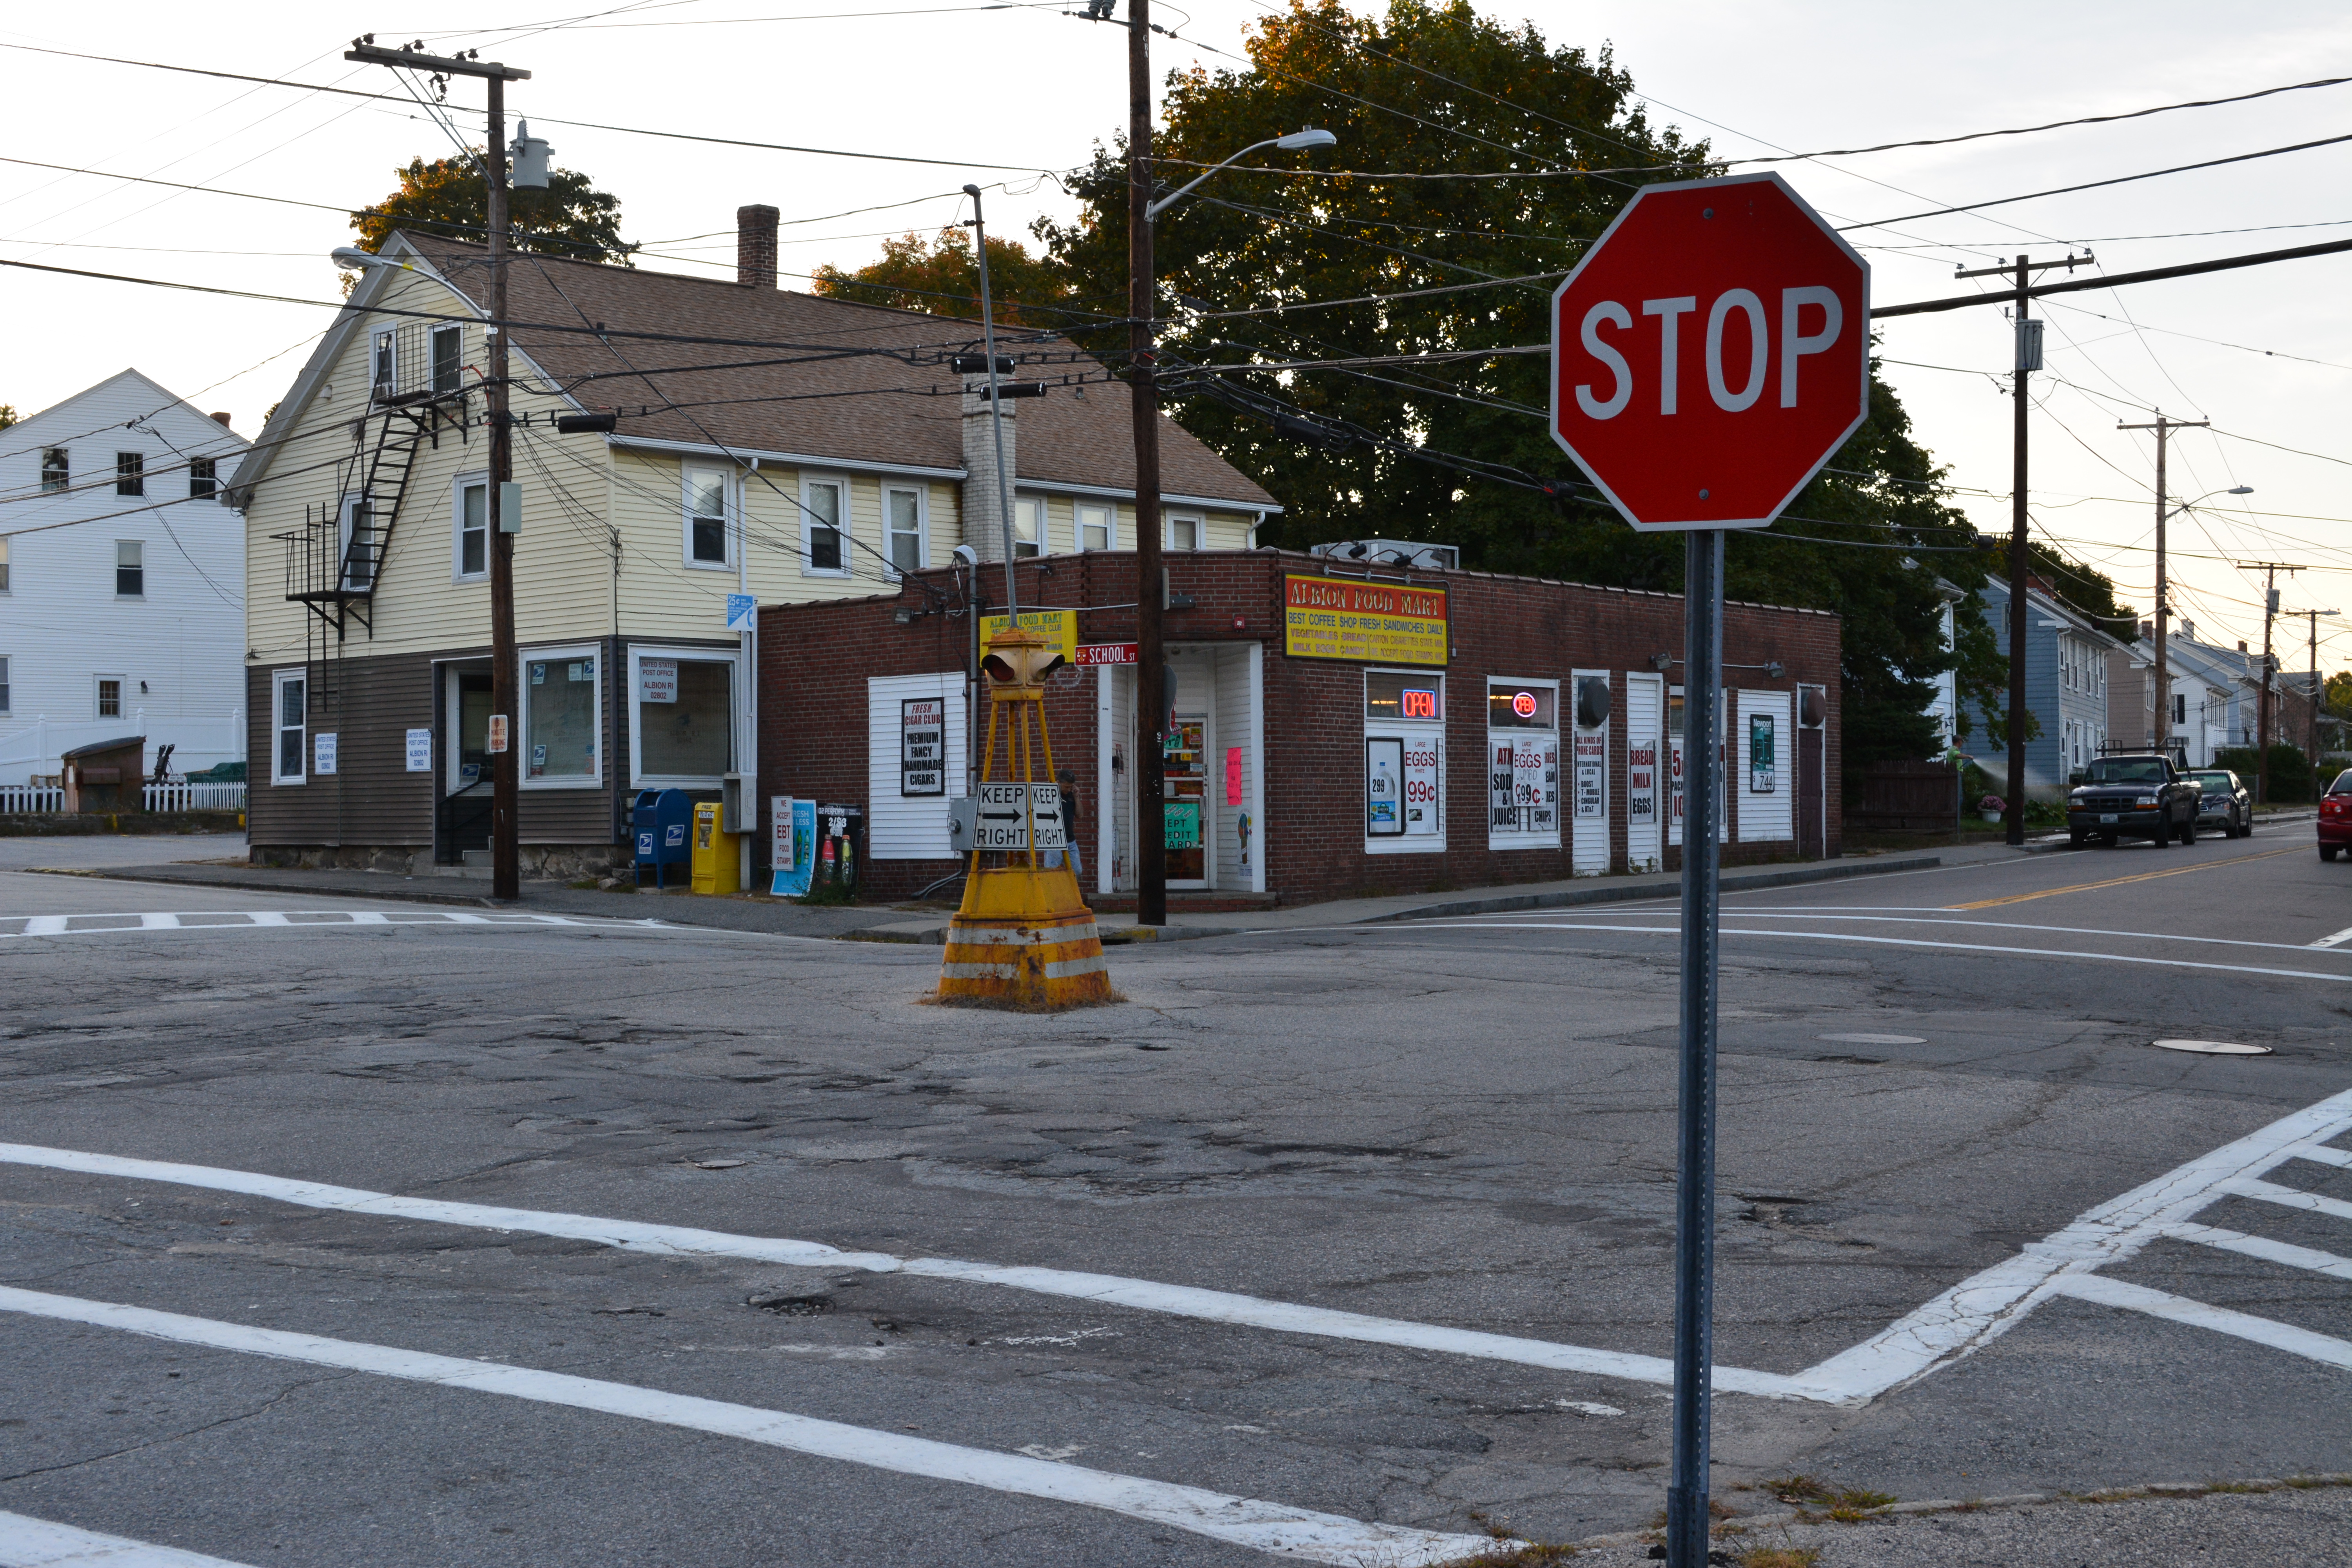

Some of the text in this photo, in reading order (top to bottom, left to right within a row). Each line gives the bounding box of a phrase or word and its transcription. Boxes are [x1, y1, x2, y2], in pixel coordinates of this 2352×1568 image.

[1575, 285, 1843, 420] STOP
[1291, 583, 1439, 616] ALBION FOOD MART
[990, 613, 1062, 628] ALBIO FOOD MART
[1289, 612, 1443, 635] BEST COFFEE SHOP FRESH SANDWICHES DAILY
[1291, 628, 1367, 642] VEGETABLES BREAD
[1369, 634, 1388, 644] CARTON
[1390, 635, 1418, 646] CIGARETTES
[1420, 638, 1433, 647] STATE
[1089, 646, 1135, 663] SCHOOL ST
[1293, 642, 1365, 655] MILK EGGS CANDY
[1381, 648, 1398, 657] ACCEPT
[1400, 650, 1413, 659] FOOD
[1416, 651, 1433, 660] STAMPS
[912, 704, 932, 714] FRESH
[1405, 692, 1434, 717] OPEN
[1515, 698, 1535, 712] OPEN
[905, 714, 940, 726] CIGAR CLUB
[1753, 718, 1771, 728] Newport
[907, 732, 939, 744] PREMIUM
[911, 746, 932, 758] FANCY
[1589, 746, 1603, 755] CARDS
[905, 759, 941, 771] HANDMADE
[1405, 751, 1435, 767] EGGS
[1514, 754, 1541, 768] EGGS
[1631, 750, 1653, 766] BREAD
[910, 773, 935, 785] CIGARS
[1517, 768, 1537, 780] JUMBO
[1546, 771, 1555, 782] EAM
[1633, 773, 1651, 788] MILK
[1372, 779, 1385, 793] 299
[1408, 781, 1435, 804] 99¢
[982, 788, 1024, 803] KEEP
[1033, 788, 1057, 804] KEEP
[1502, 792, 1508, 805] &
[1546, 791, 1555, 802] IES
[1166, 805, 1177, 814] ALBION
[1174, 808, 1183, 816] FOOD
[1633, 798, 1651, 814] EGGS
[1674, 795, 1682, 817] IC
[1494, 808, 1516, 825] JUICE
[1535, 810, 1551, 822] CHIPS
[777, 825, 790, 838] EBT
[977, 829, 1025, 844] RIGHT
[1035, 829, 1063, 844] RIGHT
